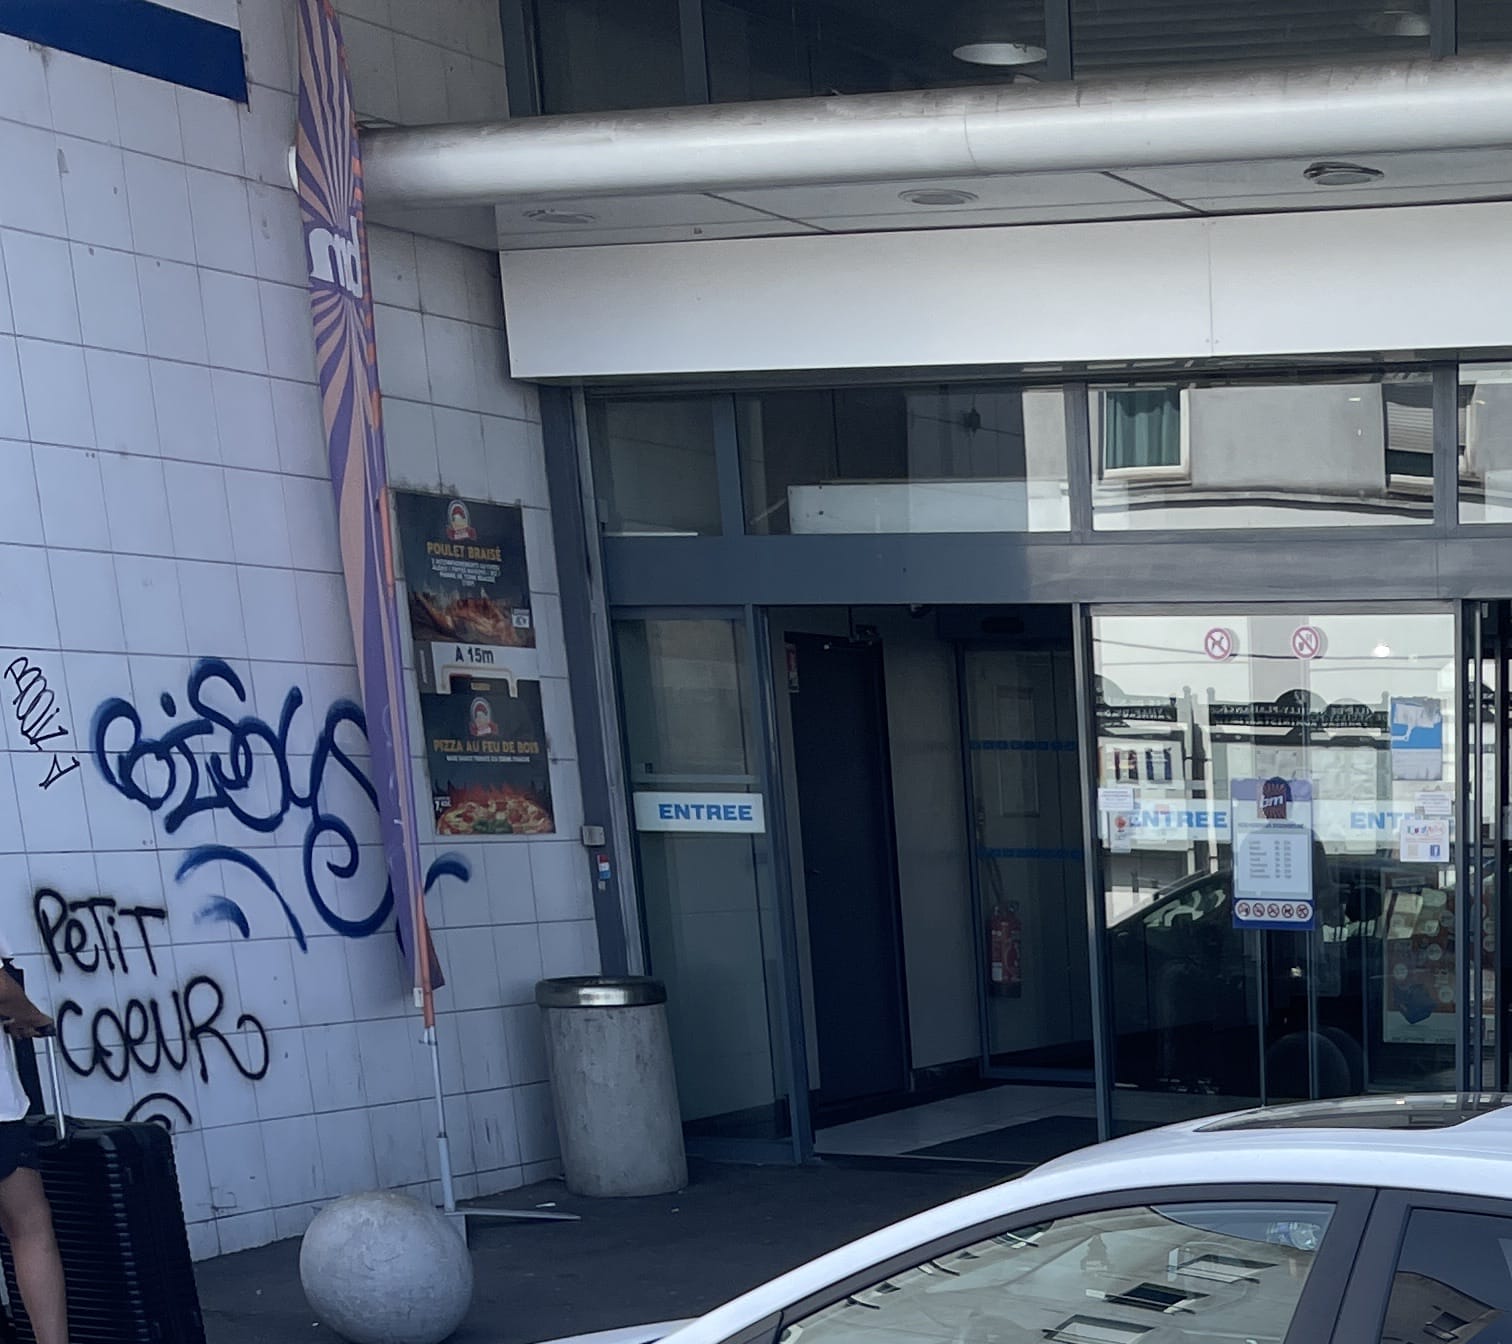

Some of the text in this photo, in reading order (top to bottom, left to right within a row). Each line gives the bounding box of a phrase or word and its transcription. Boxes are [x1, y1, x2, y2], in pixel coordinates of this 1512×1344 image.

[426, 541, 502, 562] POULET BRAISÉ
[455, 645, 494, 664] A 15m
[433, 739, 539, 754] PIZZA AU FEU DE BOIS
[658, 803, 753, 821] ENTREE
